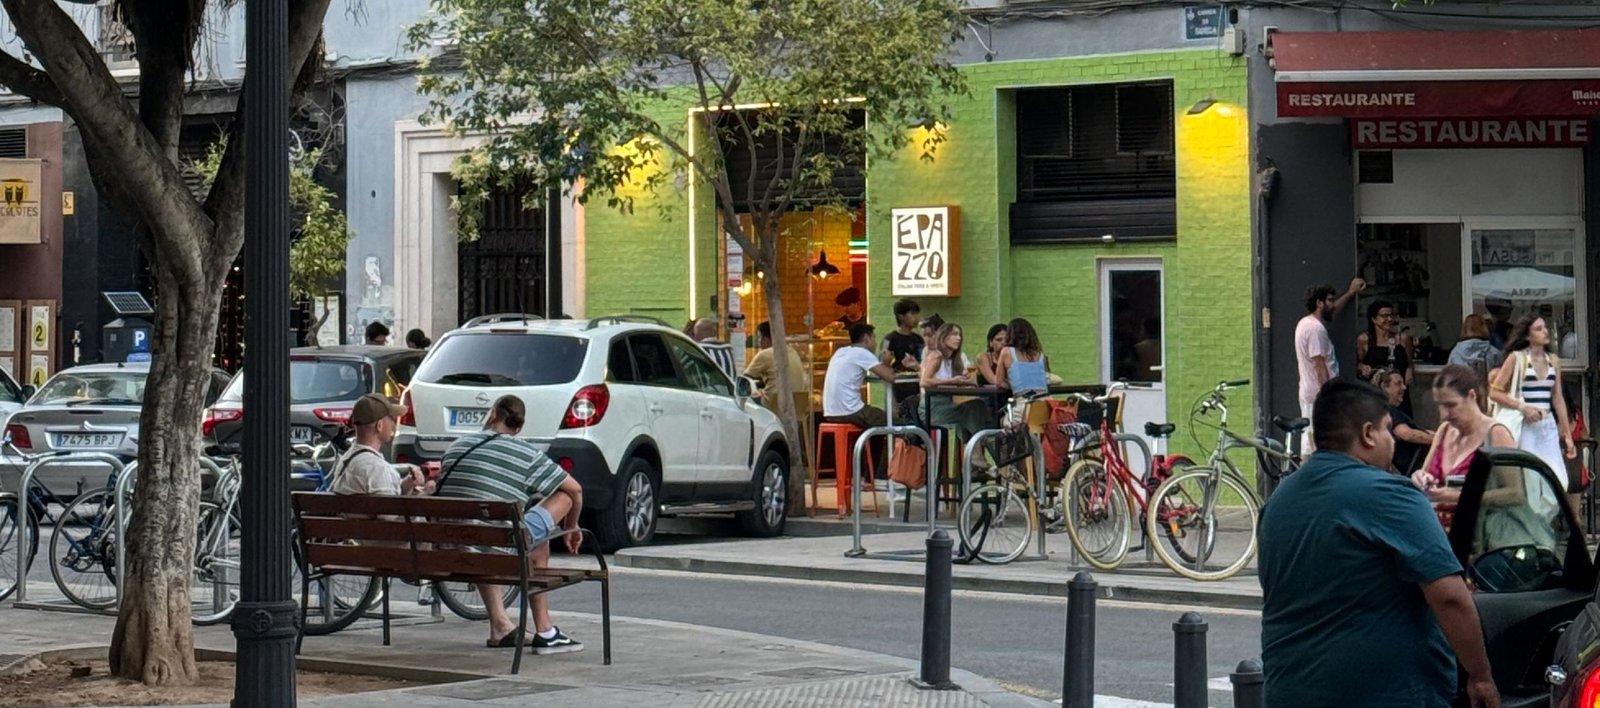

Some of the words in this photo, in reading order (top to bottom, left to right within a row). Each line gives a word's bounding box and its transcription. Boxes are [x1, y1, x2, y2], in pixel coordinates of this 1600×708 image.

[1288, 93, 1416, 106] RESTAURANTE
[1357, 120, 1588, 143] RESTAURANTE
[35, 325, 43, 342] 2
[135, 331, 145, 346] P
[458, 411, 487, 424] 0057
[63, 435, 91, 445] 7475
[95, 435, 116, 445] BPJ
